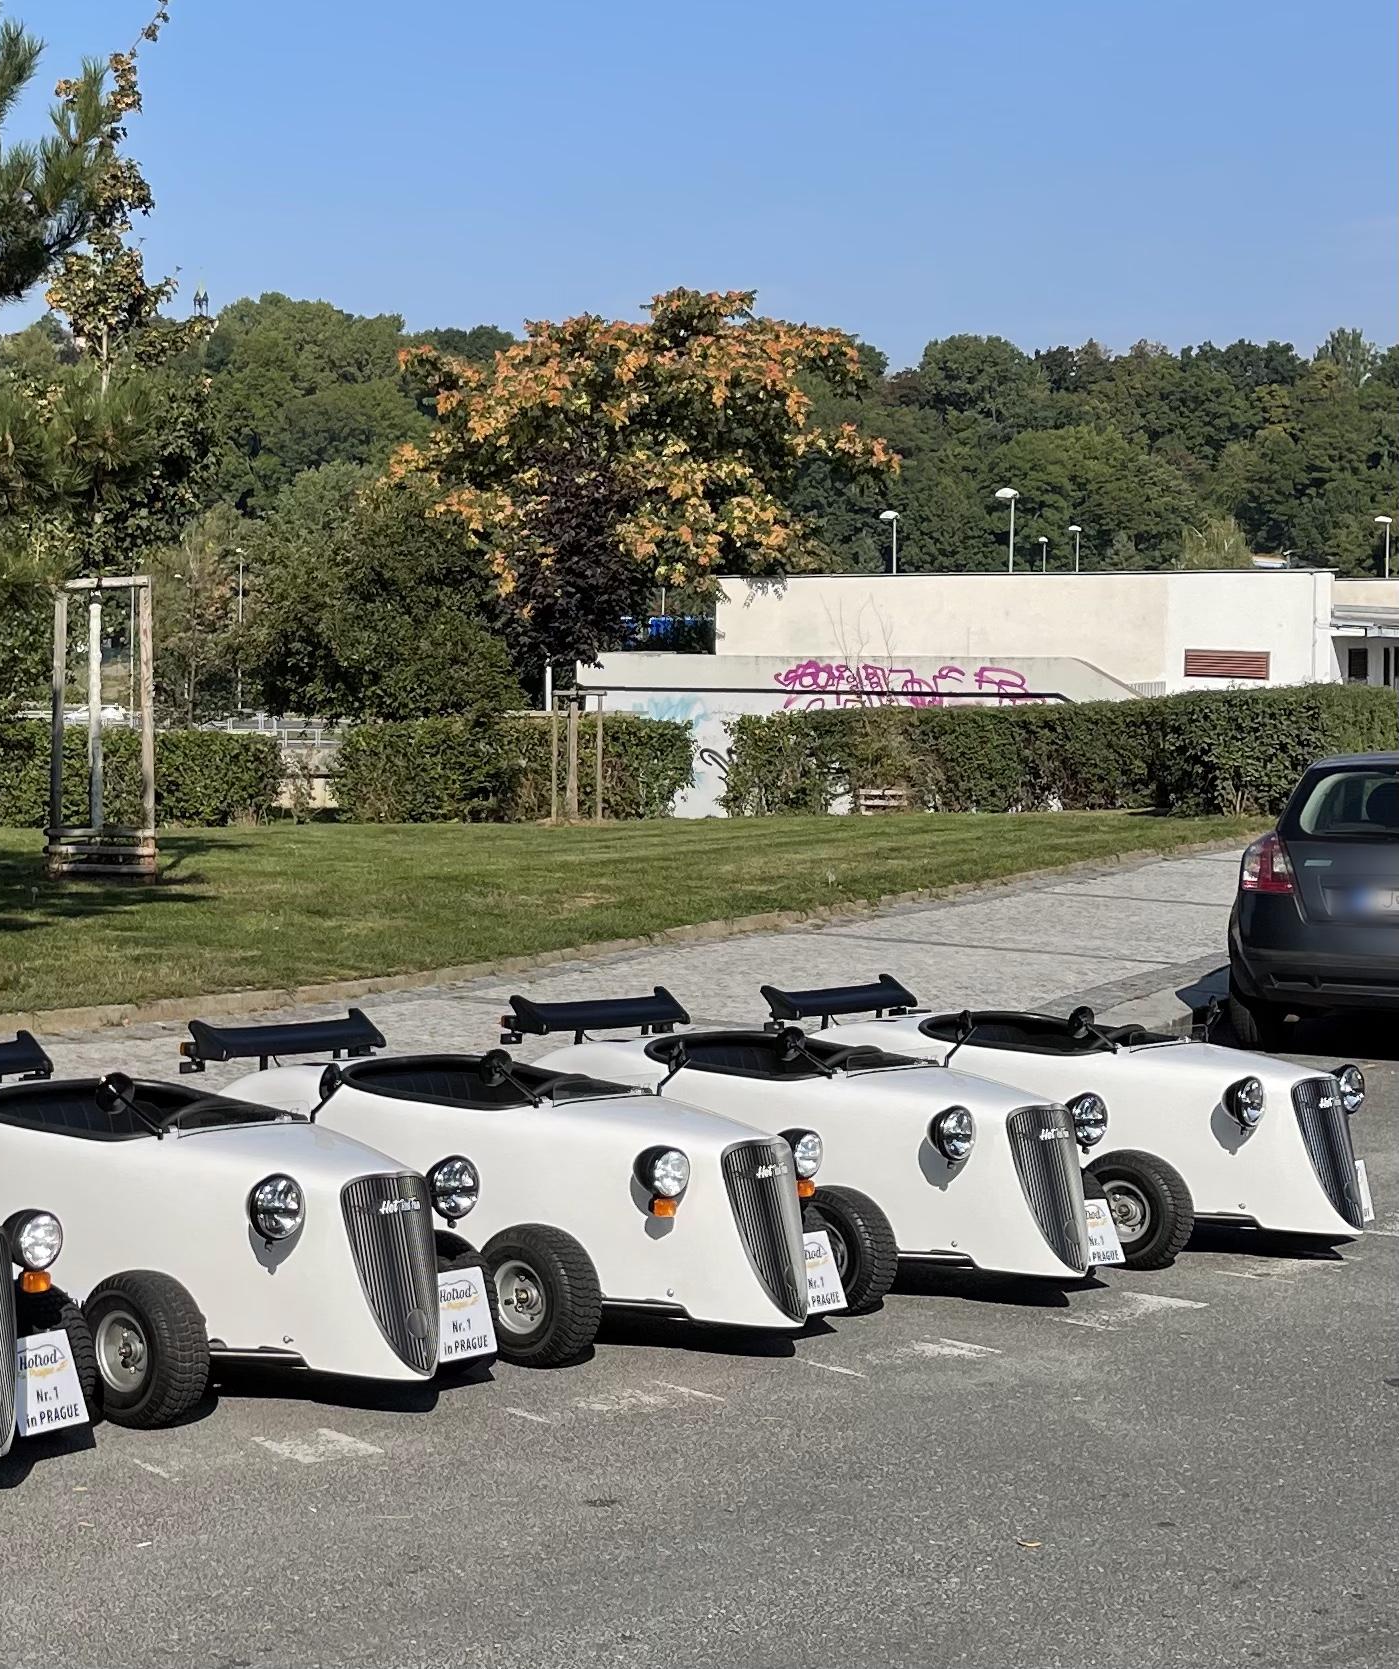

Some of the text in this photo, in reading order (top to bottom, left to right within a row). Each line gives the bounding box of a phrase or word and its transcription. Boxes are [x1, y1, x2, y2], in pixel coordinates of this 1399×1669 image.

[811, 1291, 841, 1307] PRAGUE
[466, 1318, 472, 1331] 1
[444, 1334, 488, 1356] in PRAGUE
[19, 1348, 58, 1371] Hotrod
[36, 1386, 59, 1403] Nr. 1
[26, 1403, 80, 1428] in PRAGUE
